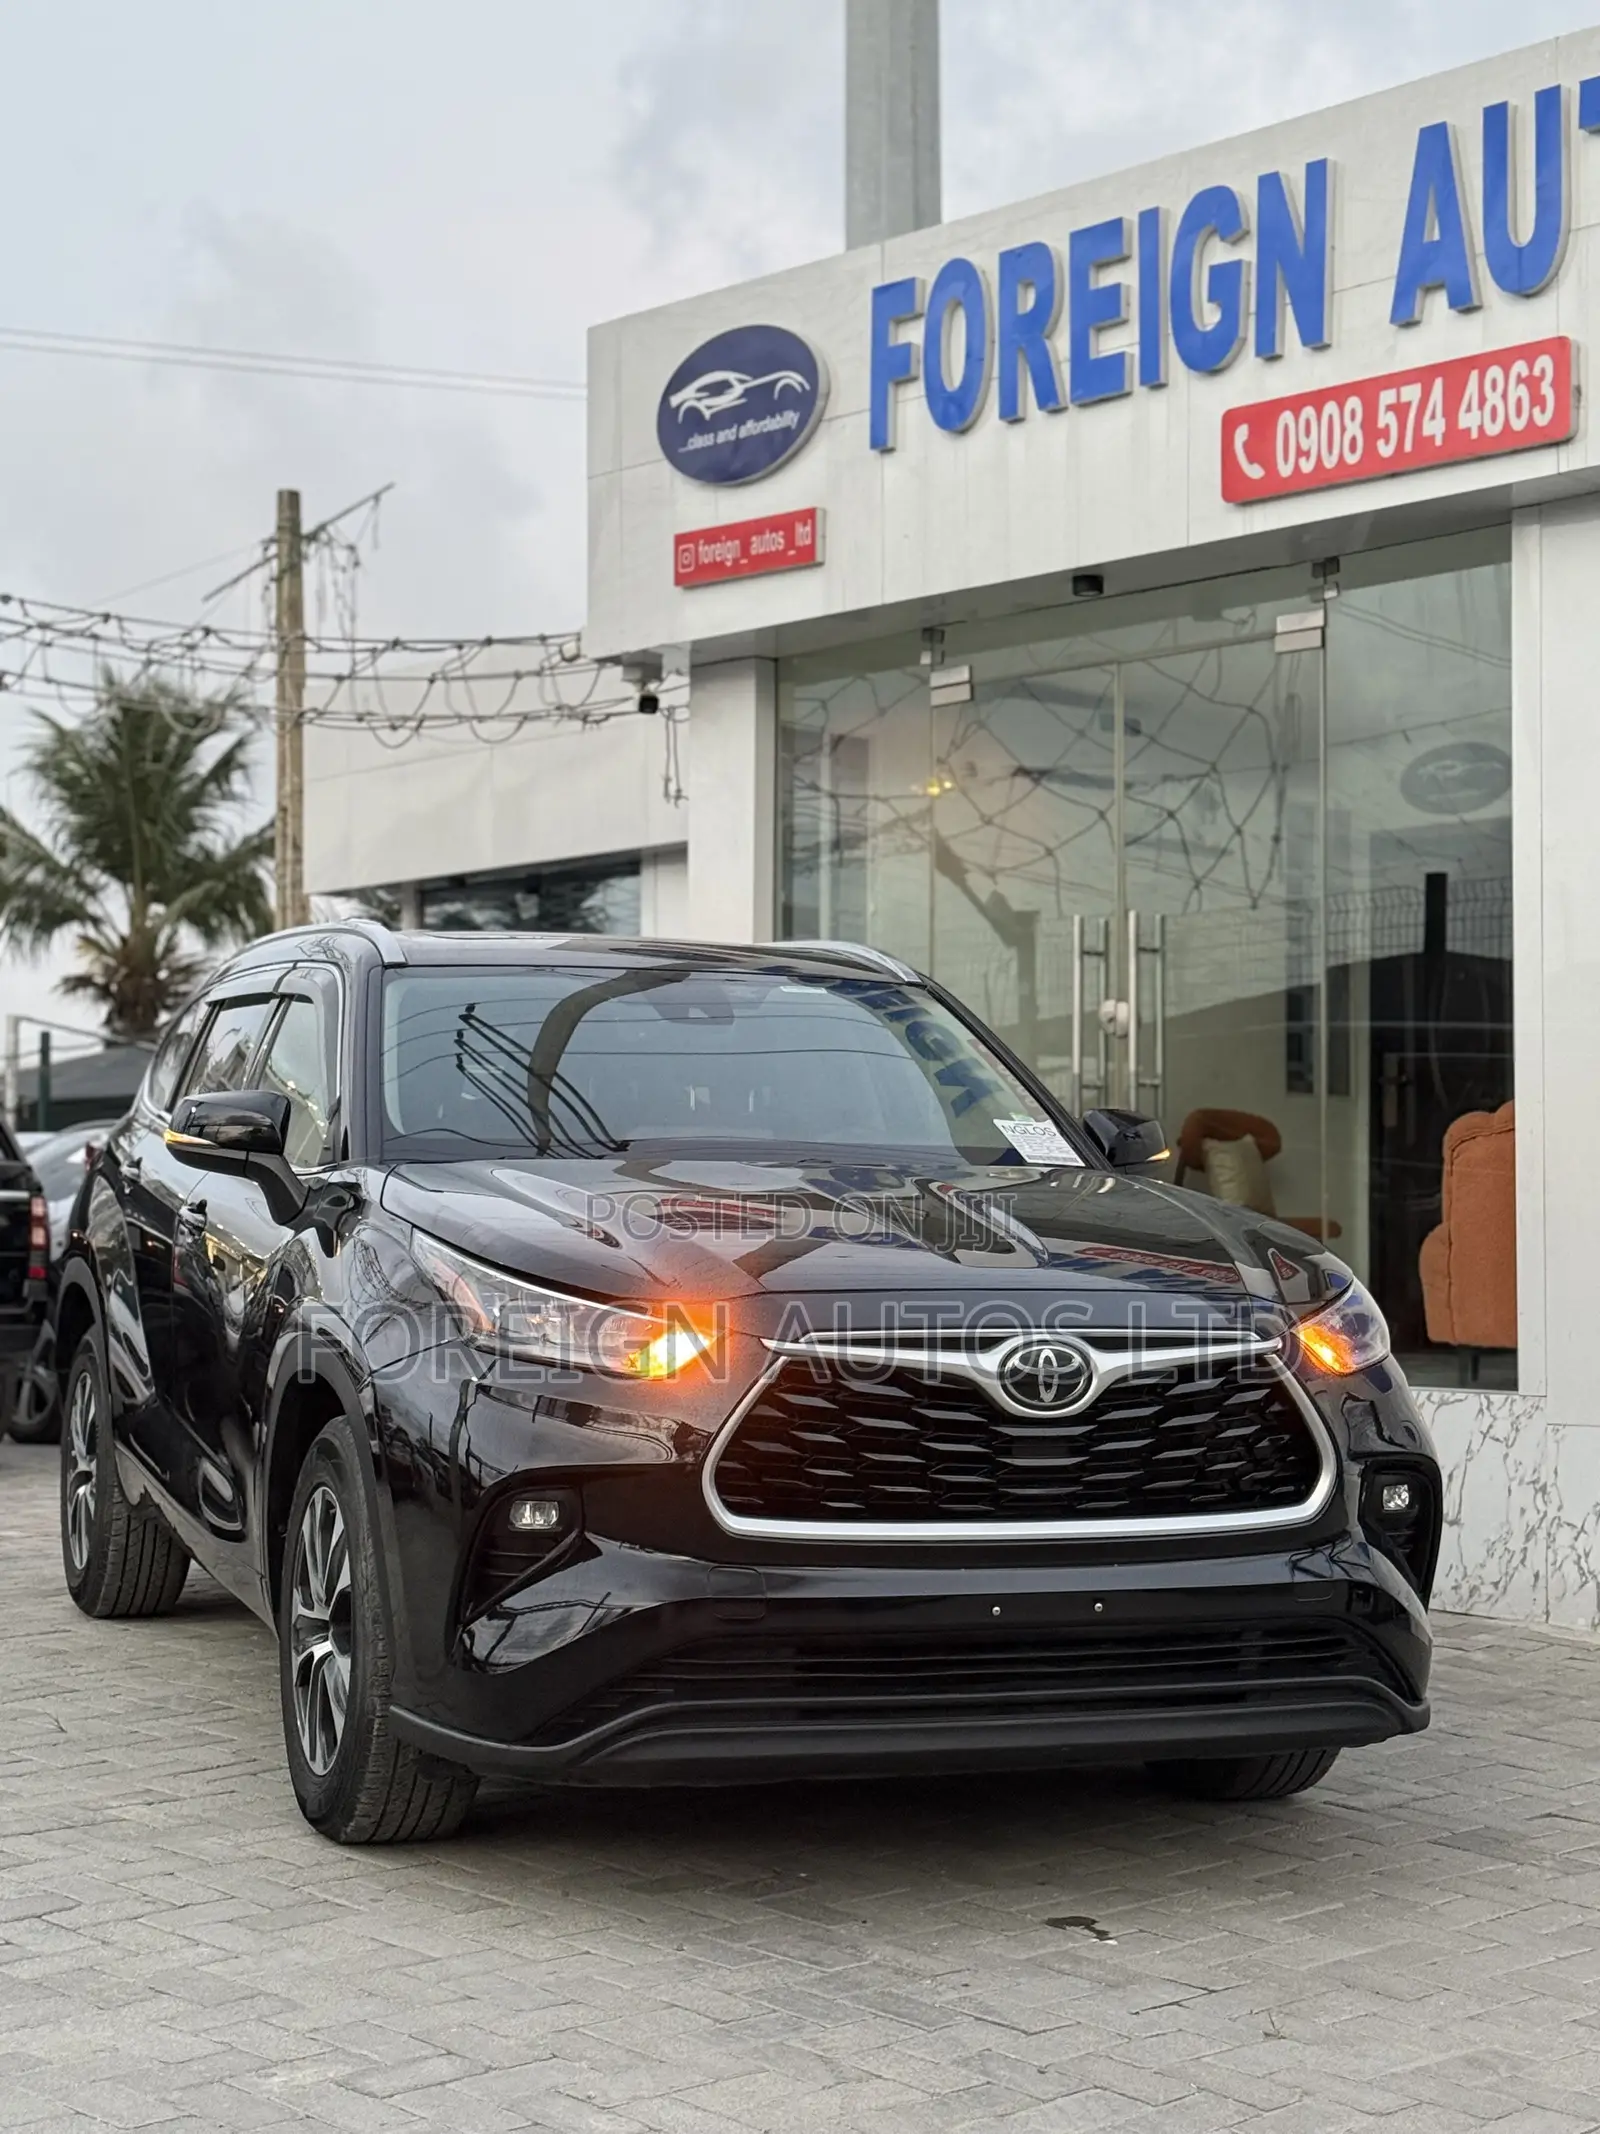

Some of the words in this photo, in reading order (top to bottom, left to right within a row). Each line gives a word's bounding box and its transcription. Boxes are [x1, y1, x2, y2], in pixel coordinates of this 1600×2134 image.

[868, 157, 1331, 452] FOREIGN
[1390, 74, 1600, 327] AU
[716, 423, 738, 444] and
[738, 409, 800, 440] affordability
[1275, 395, 1364, 478] 0908
[1376, 376, 1446, 459] 574
[1458, 354, 1555, 440] 4863
[1001, 1124, 1057, 1138] NGLOS
